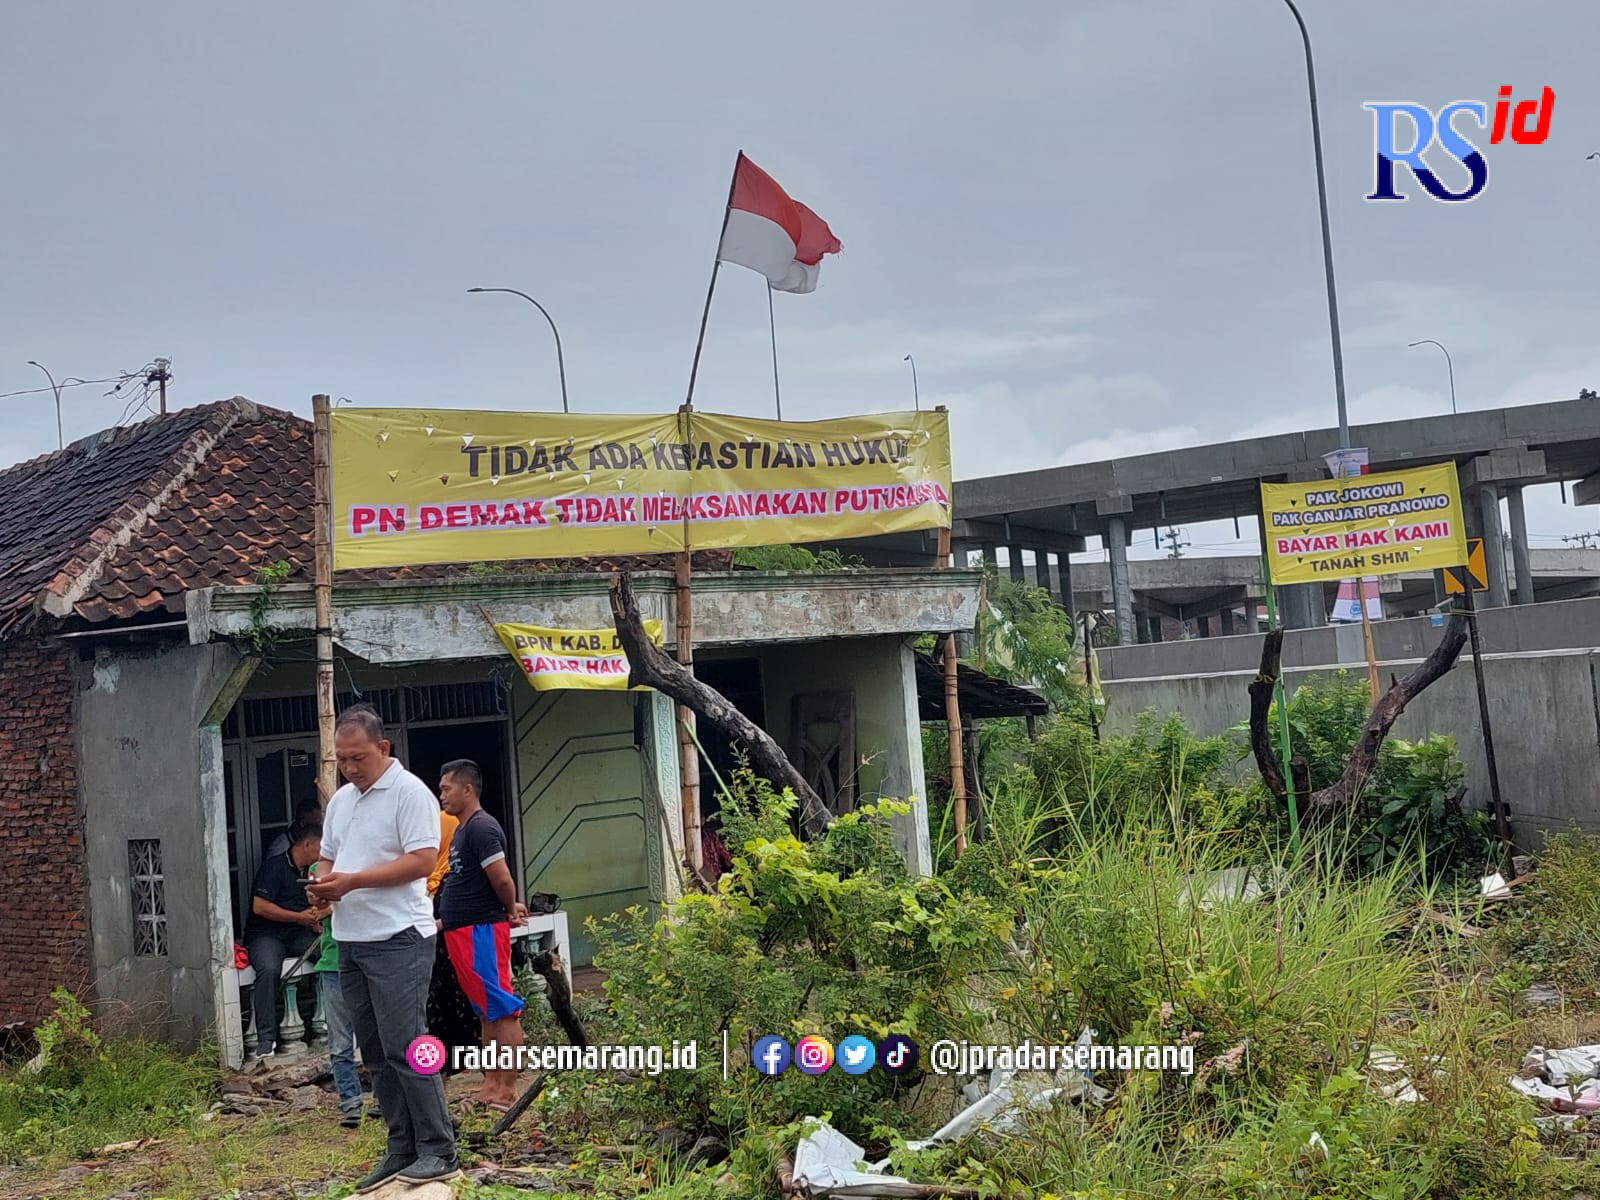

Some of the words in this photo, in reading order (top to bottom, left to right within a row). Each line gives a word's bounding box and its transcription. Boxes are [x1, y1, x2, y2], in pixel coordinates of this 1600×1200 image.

[461, 443, 580, 478] TIDAK
[588, 442, 648, 471] ADA
[653, 440, 818, 471] KEPASTIAN
[1305, 491, 1338, 507] PAK
[1340, 481, 1404, 502] JOKOWI
[352, 505, 406, 534] PN
[419, 500, 547, 530] DEMAK
[556, 496, 637, 523] TIDAK
[642, 491, 828, 522] MELAKSANAKAN
[1272, 511, 1301, 527] PAK
[1302, 506, 1367, 526] GANJAR
[1367, 494, 1450, 518] PRANOWO
[1277, 534, 1339, 555] BAYAR
[1344, 529, 1390, 548] HAK
[1394, 521, 1450, 543] KAMI
[1310, 556, 1366, 573] TANAH
[1371, 550, 1410, 566] SHM
[513, 634, 553, 651] BPN
[560, 634, 607, 651] KAB.
[520, 656, 581, 675] BAYAR
[586, 658, 627, 675] HAK
